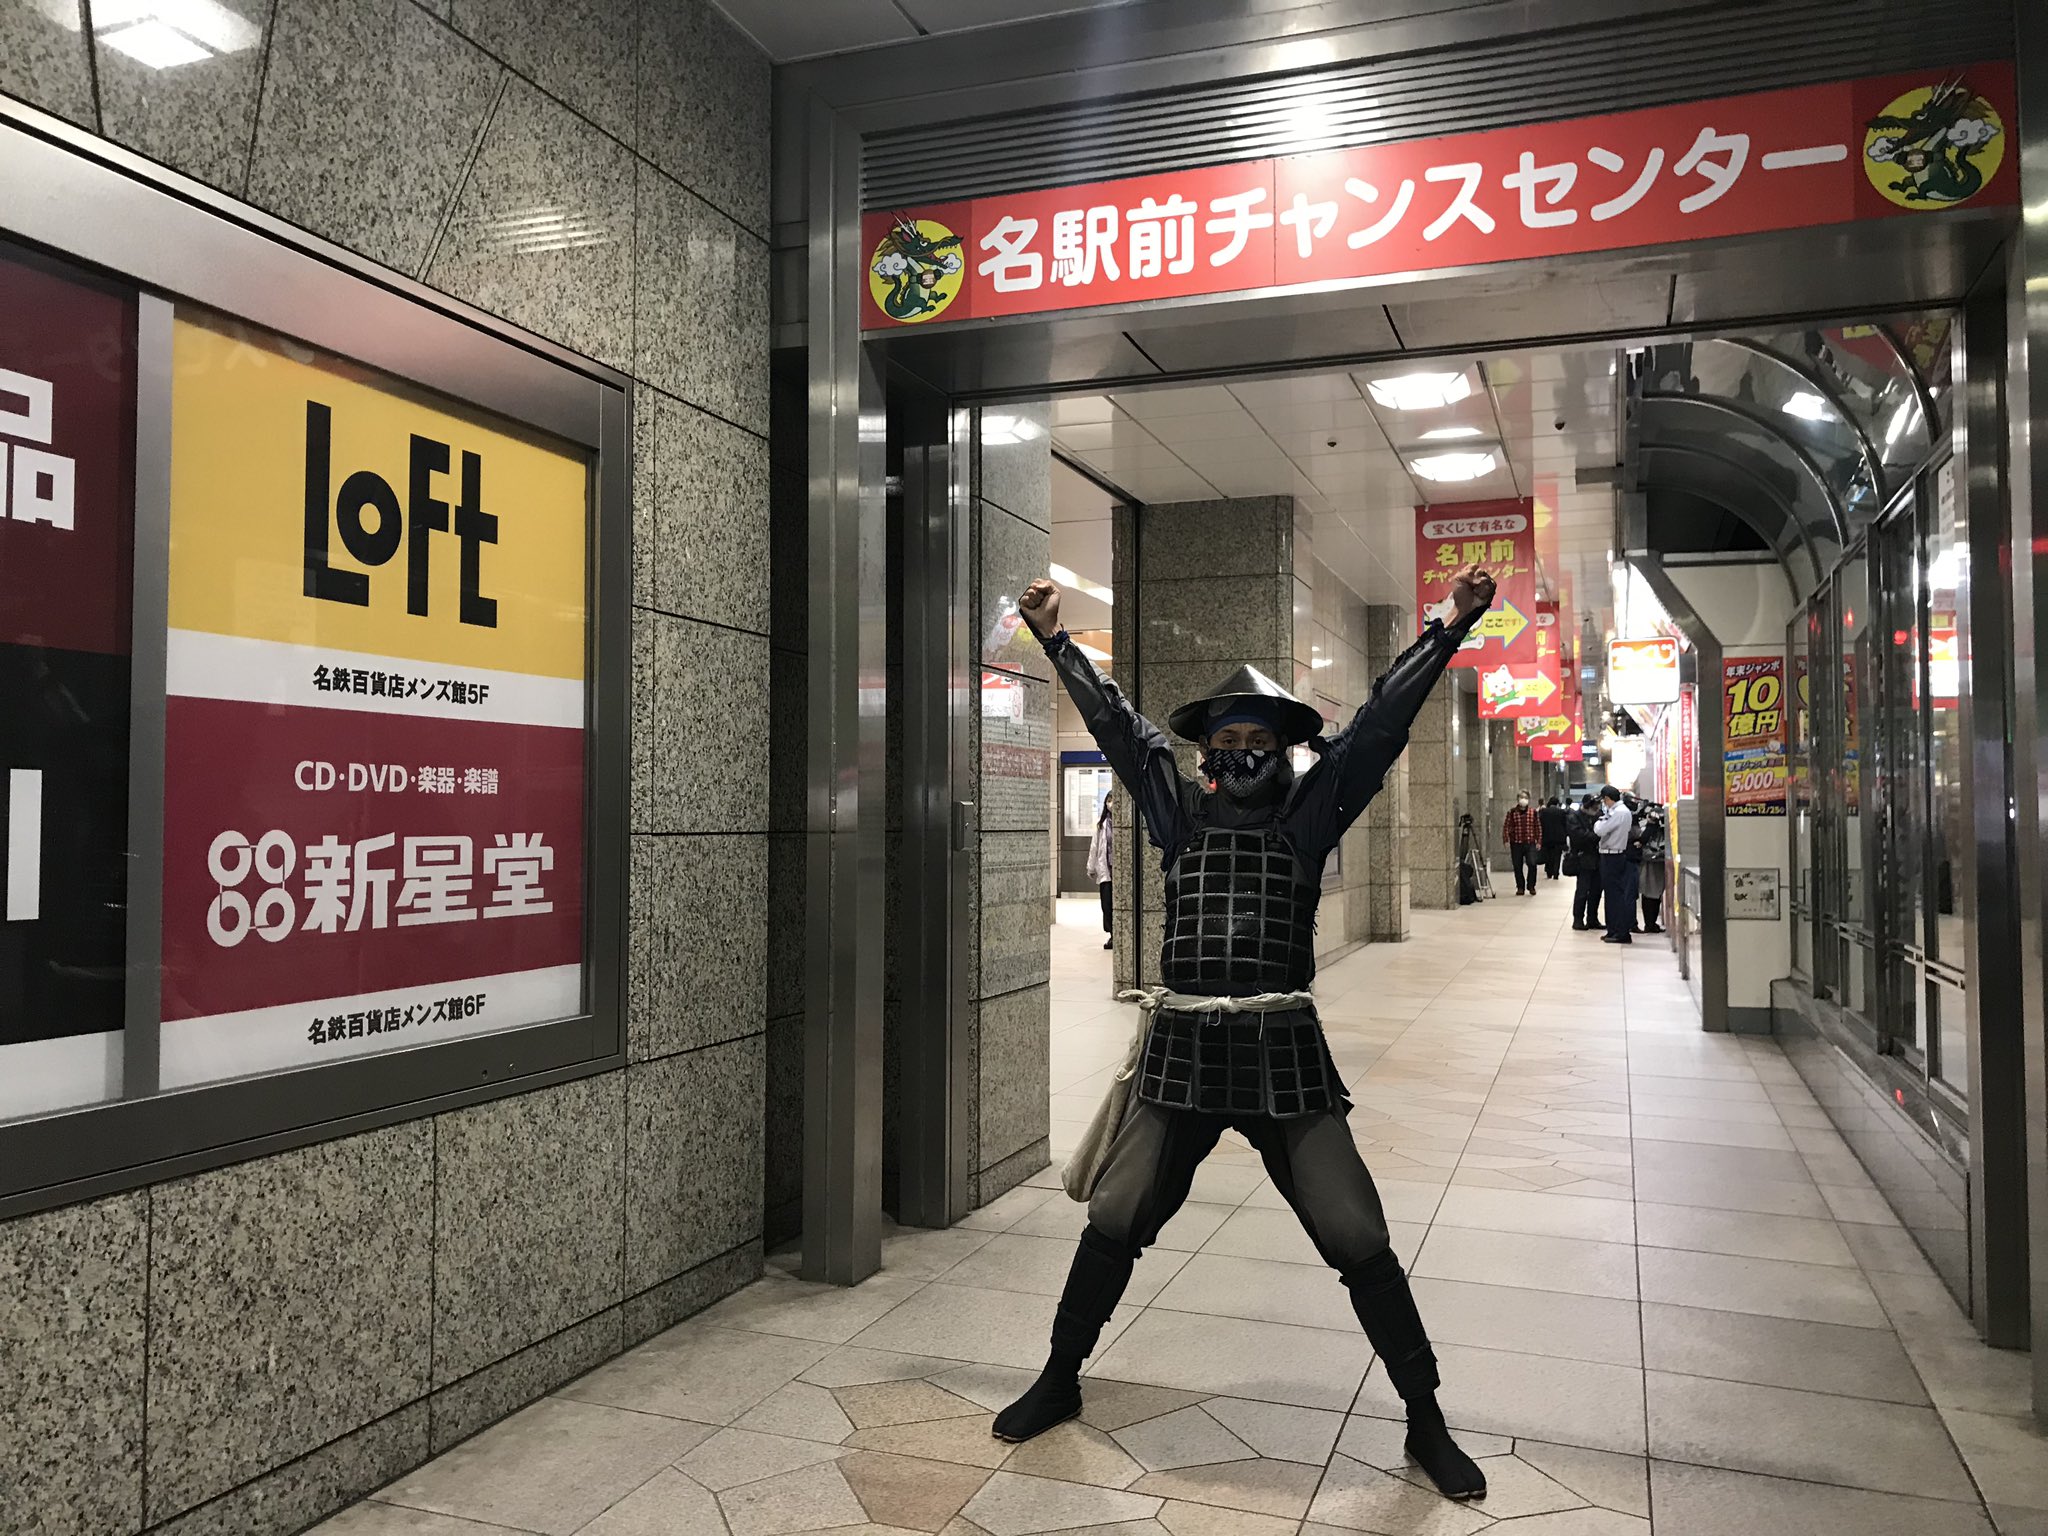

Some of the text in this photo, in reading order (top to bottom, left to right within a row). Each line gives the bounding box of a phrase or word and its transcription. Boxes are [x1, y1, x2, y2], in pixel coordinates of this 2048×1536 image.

[978, 127, 1848, 293] 名駅前チャンスセンター
[1432, 519, 1516, 536] 宝くじで有名な
[1436, 539, 1515, 567] 名駅前
[313, 664, 490, 705] 名鉄百貨店メンズ館5F
[1728, 675, 1780, 714] 10
[1728, 710, 1779, 737] 億円
[301, 831, 555, 934] 新星堂
[307, 993, 487, 1045] 名鉄百貨店メンズ館6F
